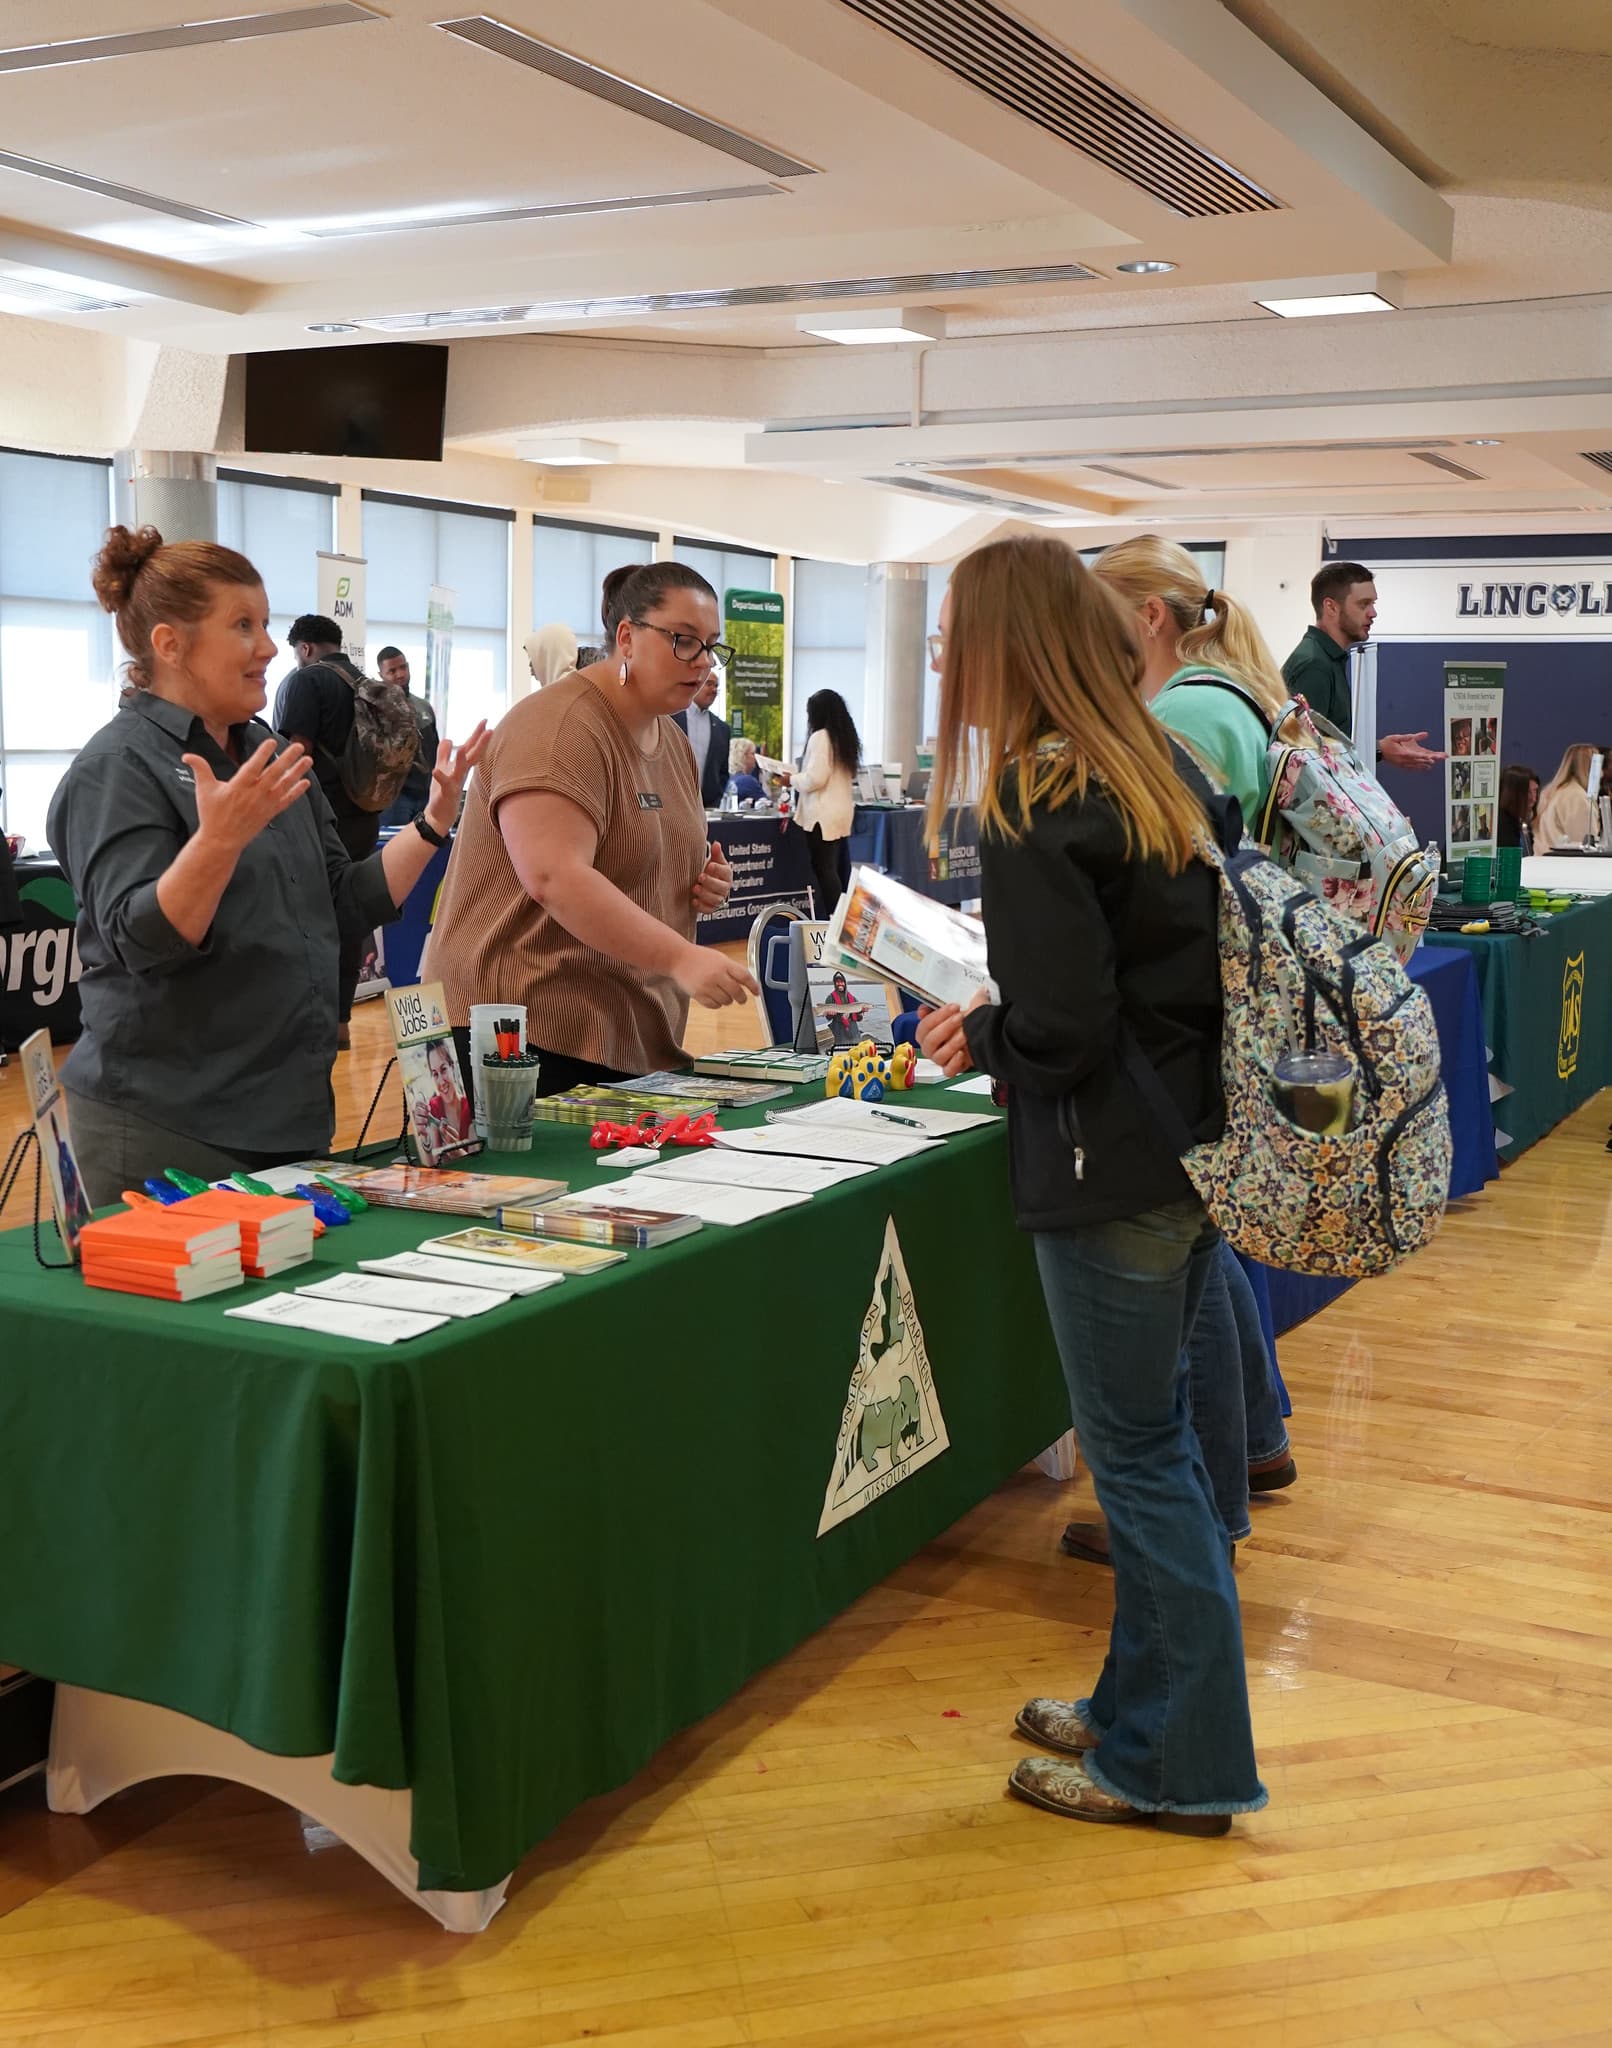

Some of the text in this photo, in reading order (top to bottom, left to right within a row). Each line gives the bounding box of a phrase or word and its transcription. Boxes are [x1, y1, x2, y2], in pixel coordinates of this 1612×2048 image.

[334, 600, 354, 618] ADM
[732, 599, 781, 612] Department Vision
[729, 843, 772, 857] United States
[767, 857, 774, 869] of
[731, 877, 764, 892] griculture
[394, 993, 422, 1016] Wild
[401, 1014, 428, 1037] Jobs
[902, 1290, 933, 1394] DEPARTMENT
[837, 1303, 880, 1451] CONSERVATION
[863, 1462, 911, 1506] MISSOURI
